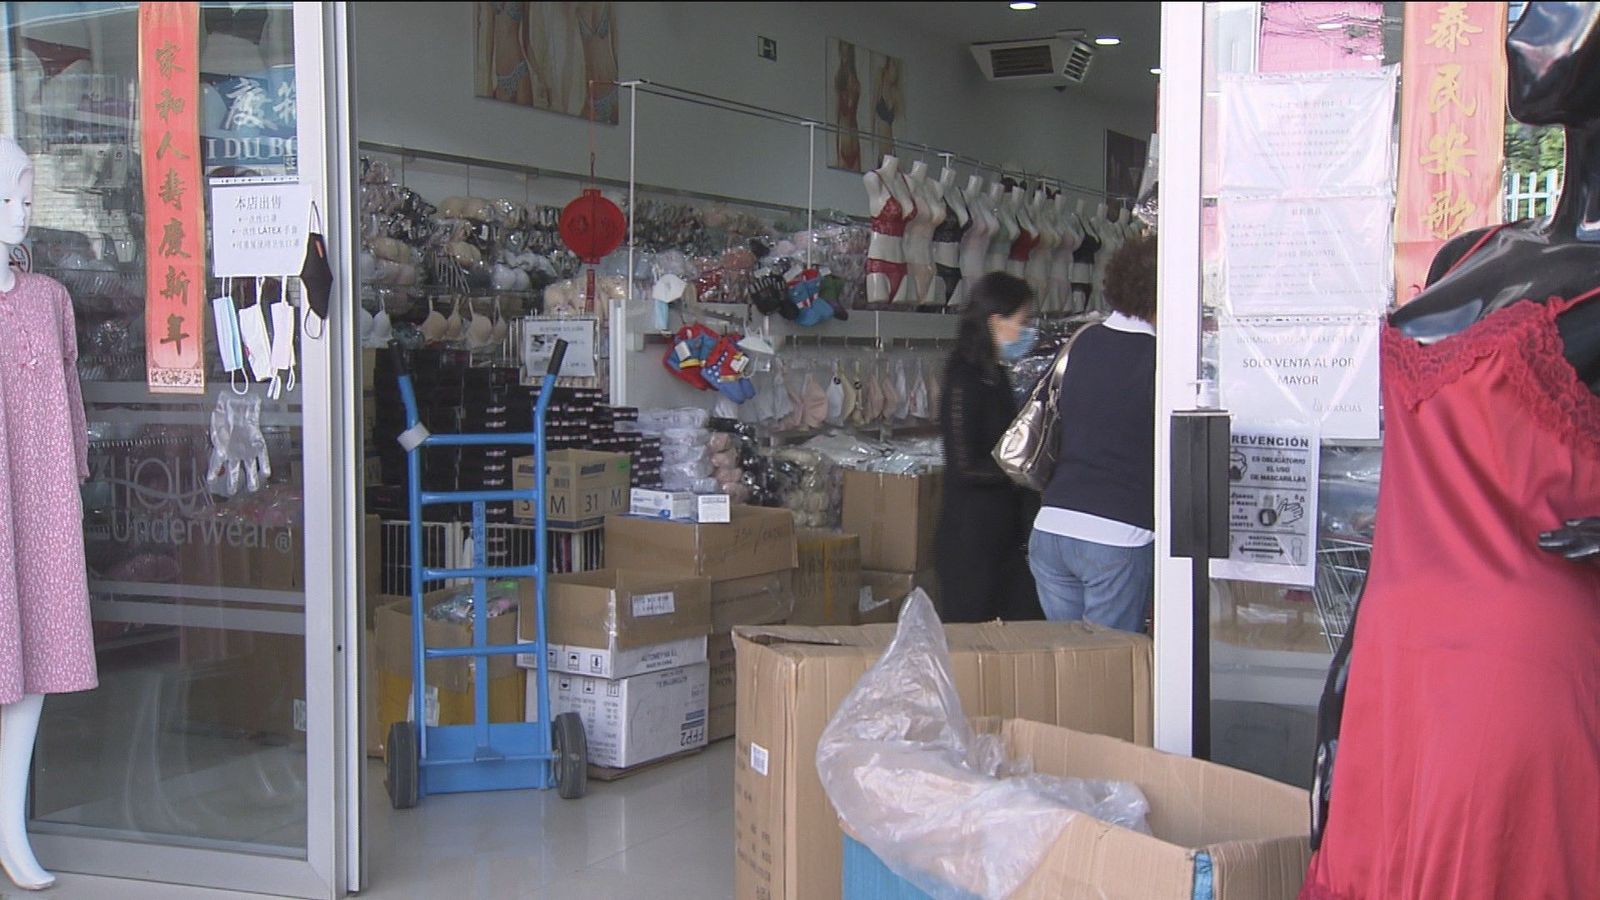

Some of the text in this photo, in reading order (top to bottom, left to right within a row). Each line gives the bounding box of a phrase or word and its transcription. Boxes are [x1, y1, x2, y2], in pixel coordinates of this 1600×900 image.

[1243, 358, 1271, 368] SOLO
[1275, 358, 1311, 368] VENTA
[1278, 375, 1319, 385] MAYOR
[1231, 434, 1310, 448] REVENCIÓN
[550, 495, 566, 515] M
[584, 493, 599, 513] 31
[611, 489, 622, 507] M
[111, 509, 273, 550] Underwear
